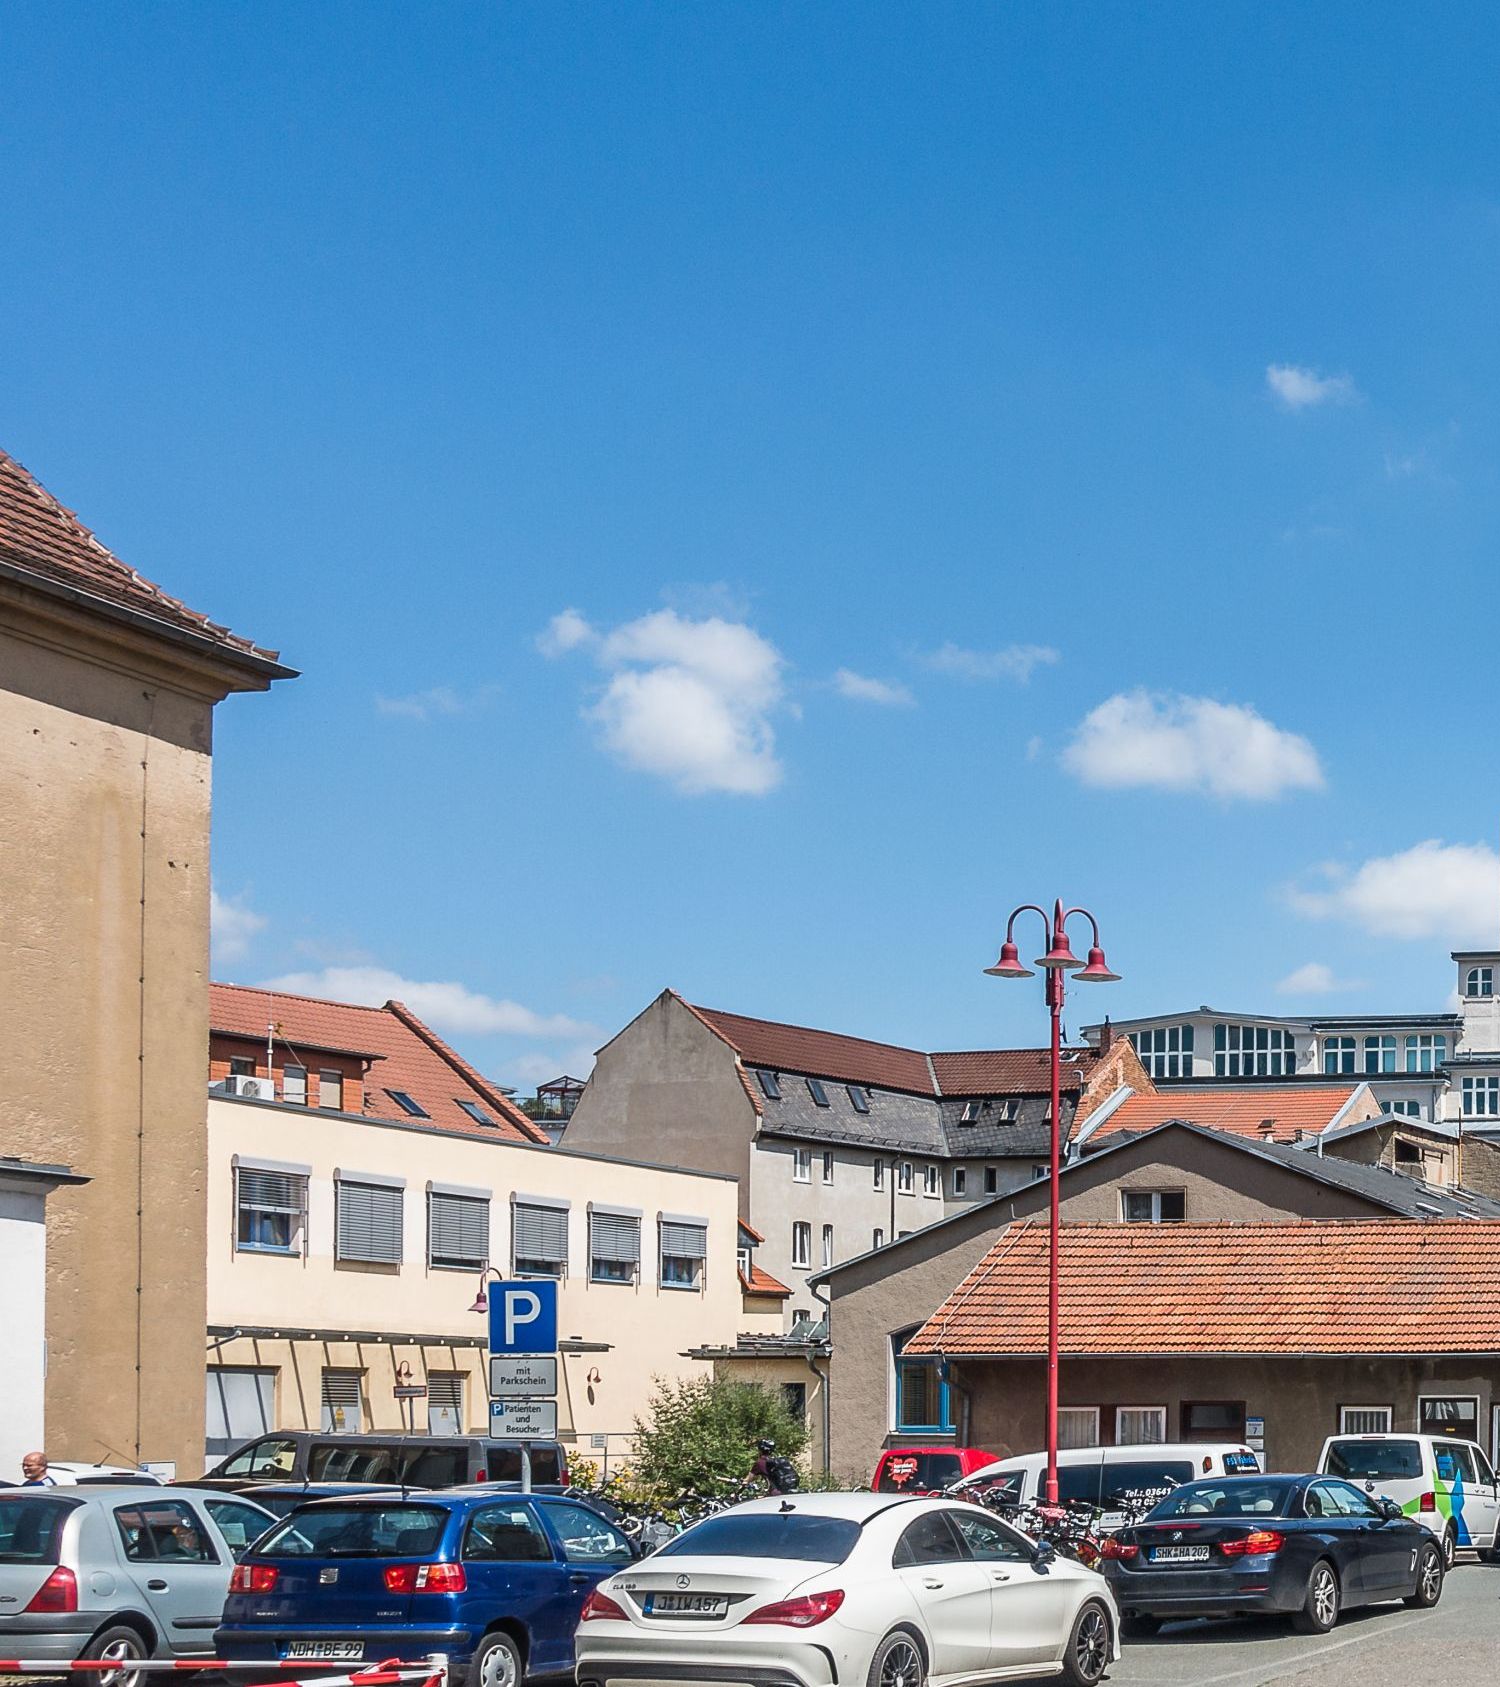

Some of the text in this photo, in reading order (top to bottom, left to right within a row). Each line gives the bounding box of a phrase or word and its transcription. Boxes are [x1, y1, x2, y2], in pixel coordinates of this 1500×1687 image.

[505, 1290, 541, 1345] P
[516, 1366, 531, 1375] mit
[500, 1376, 546, 1385] Parkschein
[493, 1404, 541, 1414] P Patienten
[515, 1415, 531, 1423] und
[506, 1425, 541, 1434] Besucher
[1145, 1487, 1172, 1497] 03641
[1156, 1547, 1209, 1558] SHK HA 202
[658, 1596, 719, 1611] J IW 157
[288, 1642, 363, 1657] NDH BE 99
